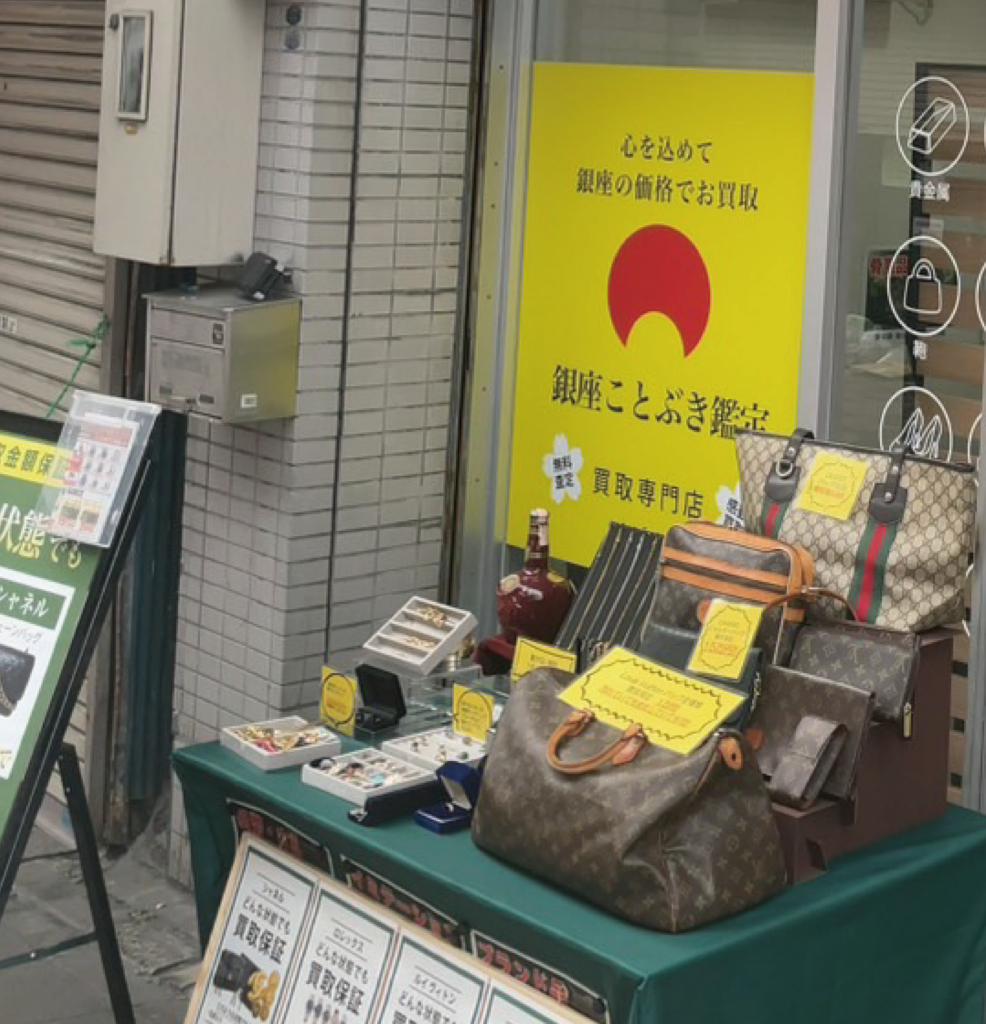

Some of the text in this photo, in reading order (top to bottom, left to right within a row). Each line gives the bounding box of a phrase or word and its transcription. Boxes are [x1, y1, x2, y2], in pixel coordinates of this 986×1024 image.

[620, 134, 714, 164] 心を込めて
[577, 168, 759, 212] 銀座の価格でお買取
[552, 365, 770, 439] 銀座ことぶき鑑定
[593, 468, 703, 518] 買取専門店
[242, 896, 291, 936] どんな状態でも
[233, 913, 287, 965] 買取保証
[332, 927, 364, 954] ロレックス
[314, 941, 369, 986] どんな状態でも
[305, 961, 365, 1016] 買取保証
